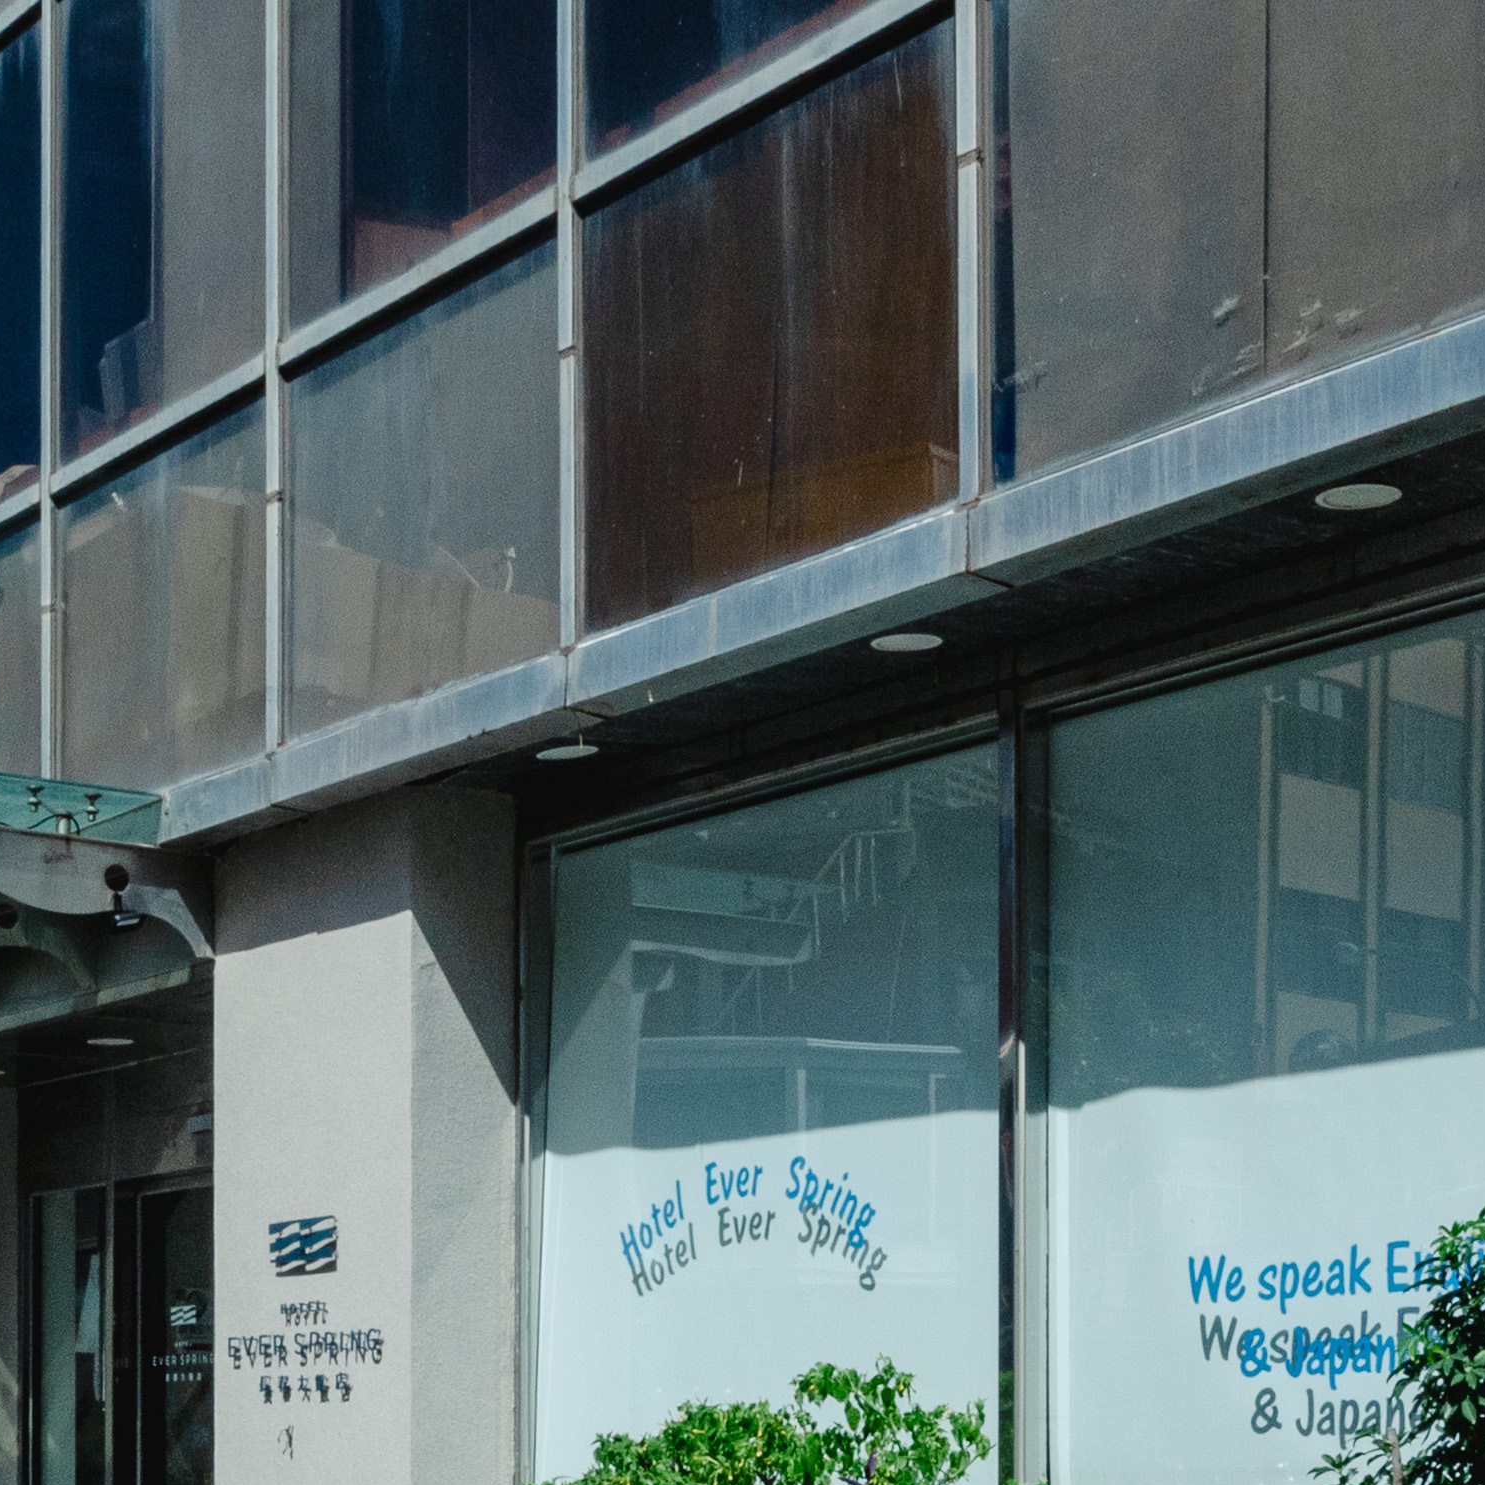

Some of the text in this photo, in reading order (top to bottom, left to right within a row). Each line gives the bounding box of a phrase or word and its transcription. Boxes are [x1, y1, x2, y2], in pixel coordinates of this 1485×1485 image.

[620, 1156, 876, 1268] Hotel Ever Spring
[1188, 1254, 1246, 1304] We
[1258, 1244, 1372, 1314] speak
[152, 1355, 177, 1366] EVER
[227, 1328, 383, 1357] EVER SPRING
[1240, 1328, 1271, 1378] &
